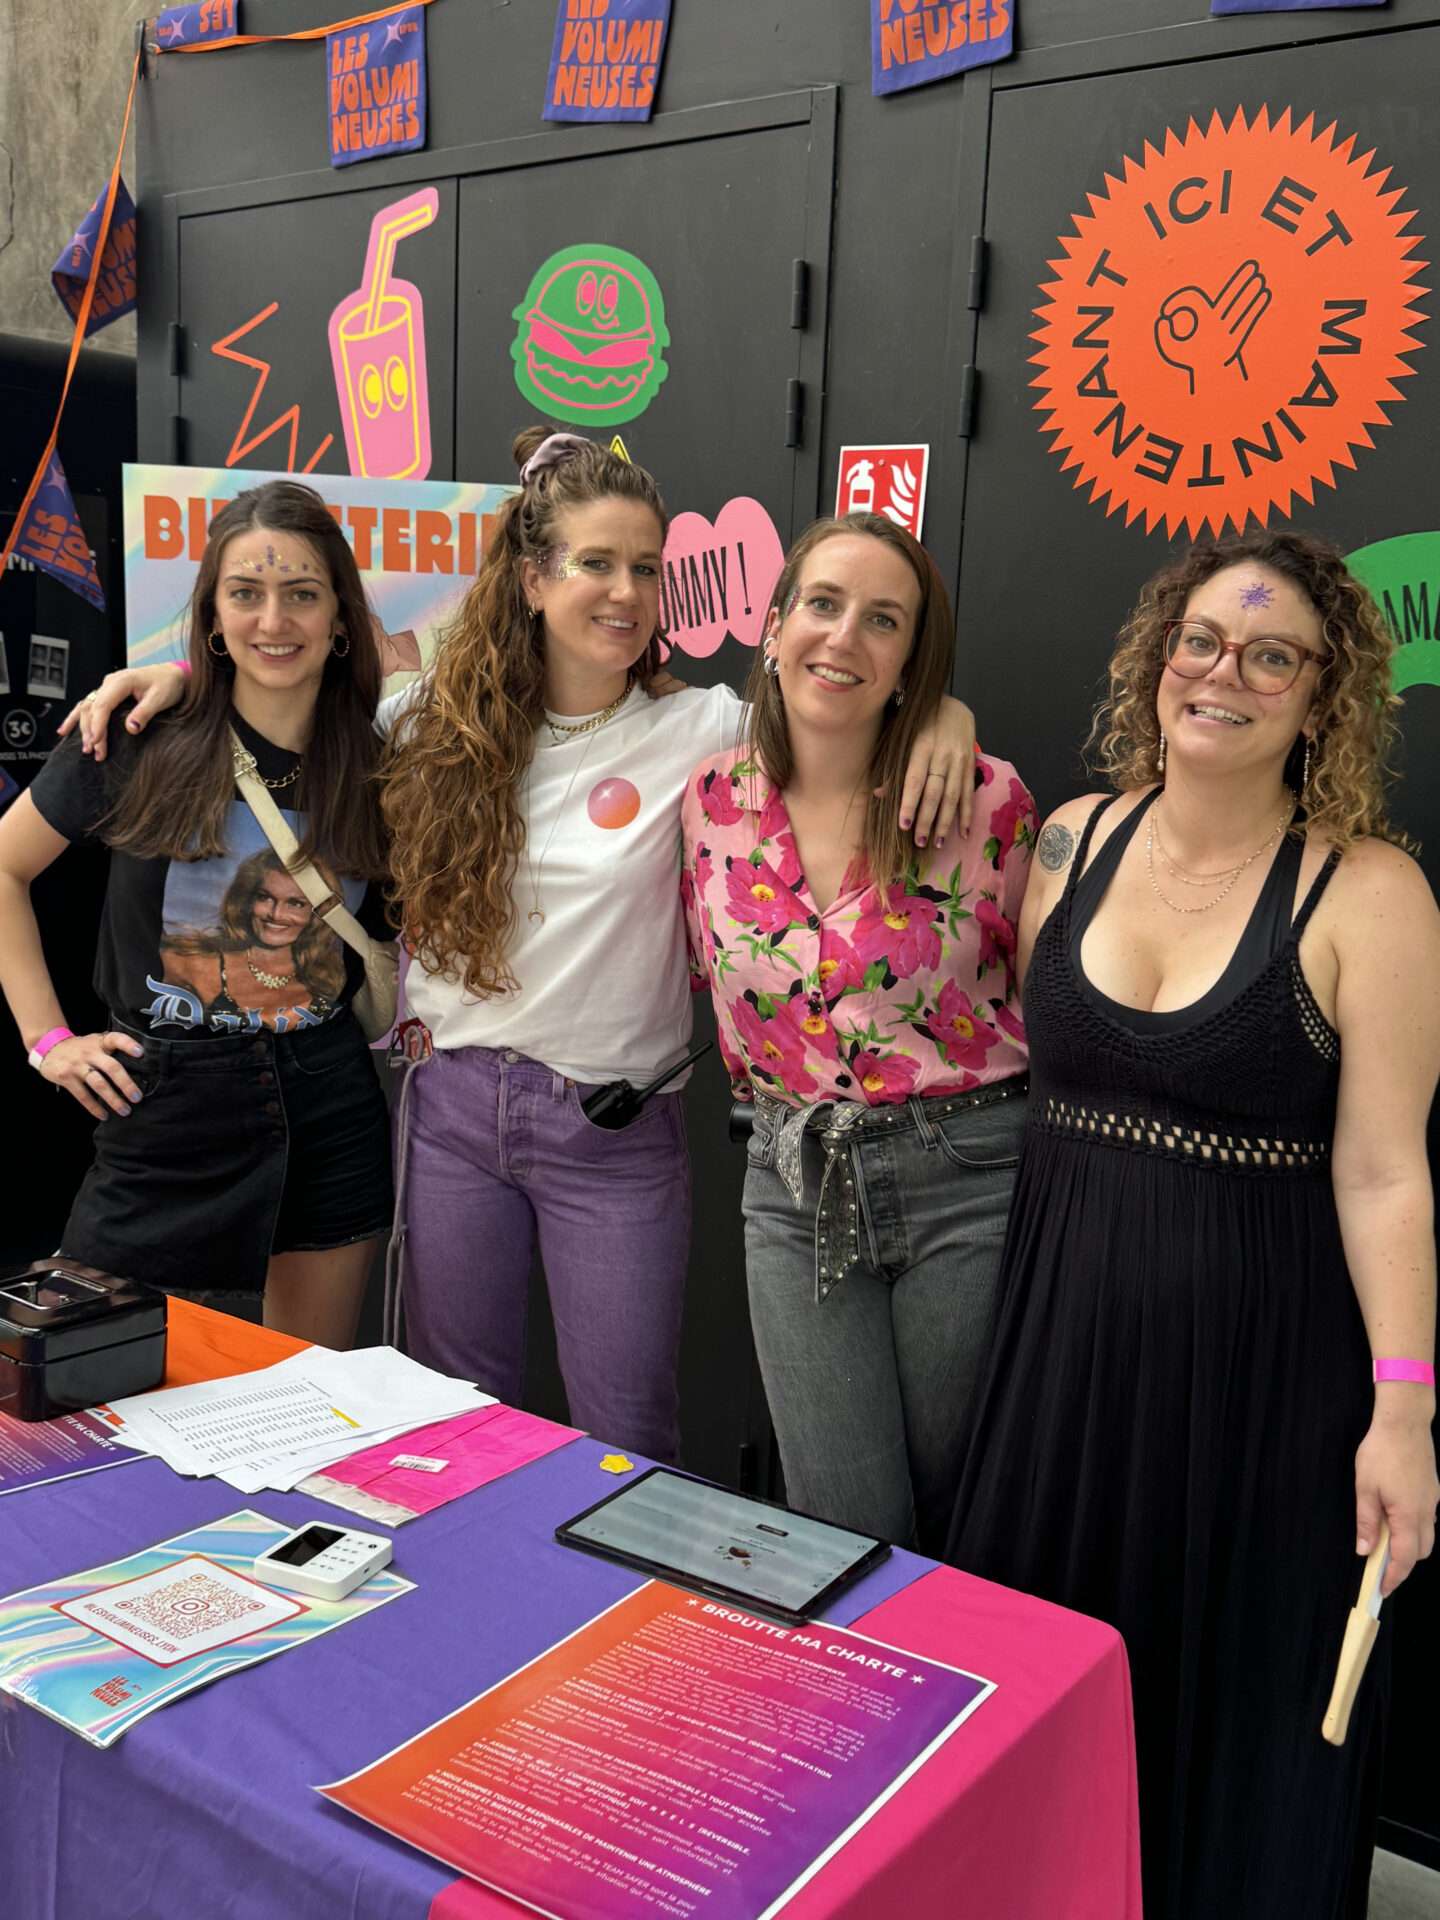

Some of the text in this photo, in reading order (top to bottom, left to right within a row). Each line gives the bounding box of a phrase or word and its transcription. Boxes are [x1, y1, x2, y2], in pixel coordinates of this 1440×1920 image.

[332, 32, 369, 76] LES
[560, 19, 664, 64] VOLUMI
[880, 0, 1010, 71] NEUSES
[331, 59, 420, 114] VOLUMI
[552, 64, 657, 108] NEUSES
[331, 103, 420, 154] NEUSES
[1072, 169, 1368, 488] ICI ET MAINTENANT
[20, 508, 68, 563] LES
[659, 545, 729, 635] UMMY
[698, 1603, 909, 1678] BROUTTE MA CHARTE
[727, 1804, 767, 1824] MOMENT
